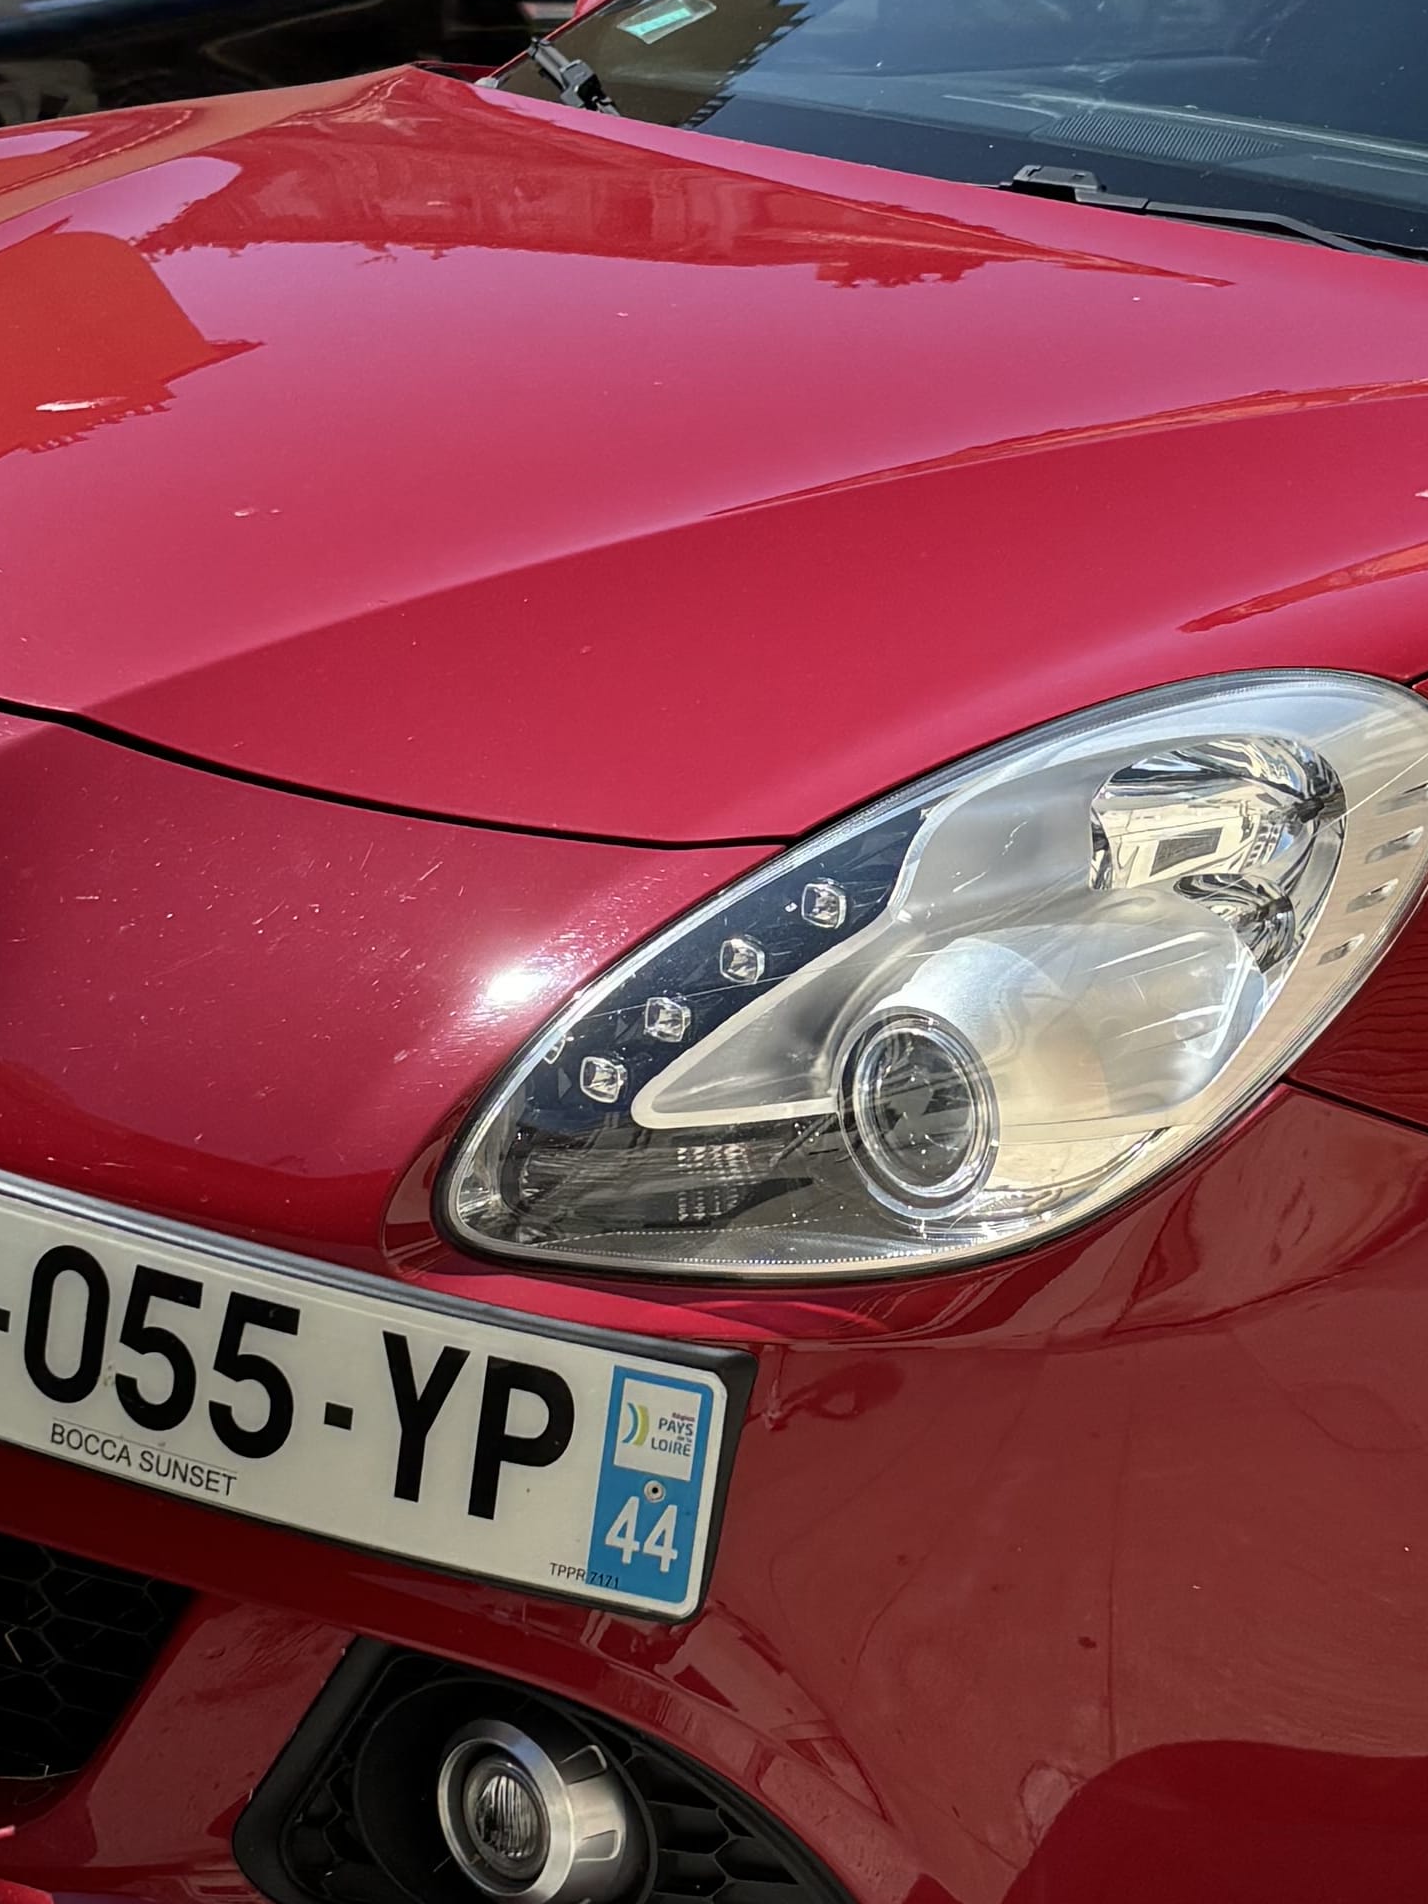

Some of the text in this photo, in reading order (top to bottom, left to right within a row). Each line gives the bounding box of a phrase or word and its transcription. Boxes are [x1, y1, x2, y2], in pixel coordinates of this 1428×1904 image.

[658, 1417, 695, 1437] PAYS
[651, 1437, 692, 1457] LOIRE
[49, 1420, 238, 1498] BOCCA SUNSET
[604, 1495, 679, 1574] 44
[549, 1561, 587, 1582] TPPR
